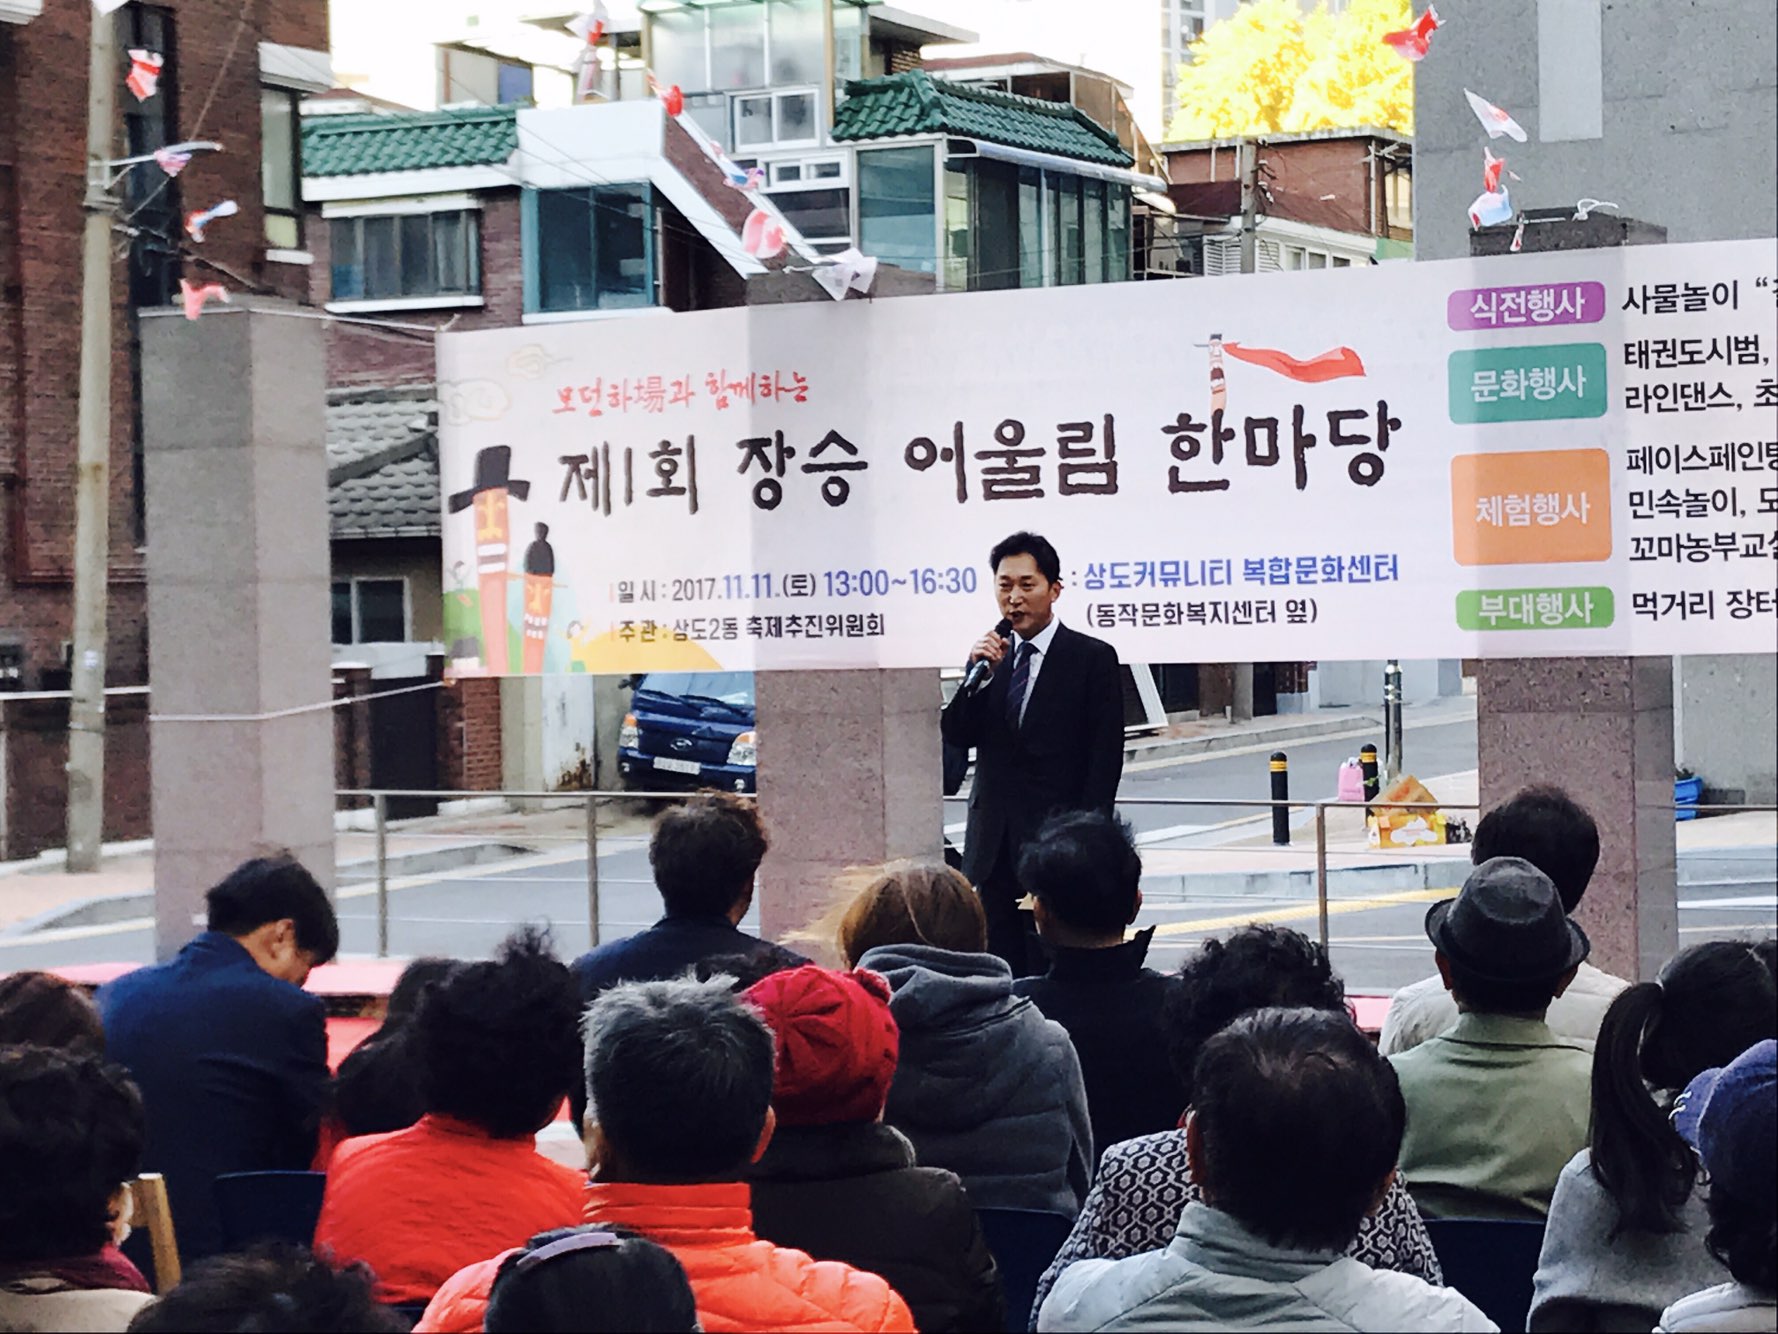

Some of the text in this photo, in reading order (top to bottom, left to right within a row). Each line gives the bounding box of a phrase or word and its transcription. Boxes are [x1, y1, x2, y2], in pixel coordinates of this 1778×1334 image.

[1469, 286, 1586, 326] 식전행사
[1621, 280, 1739, 315] 사물놀이
[1624, 334, 1770, 370] 태권도시범,
[705, 368, 809, 411] 함께하는
[1470, 366, 1586, 403] 문화행사
[1625, 381, 1742, 414] 라인댄스,
[557, 400, 1403, 517] 제1회 장승 어울림 한마당
[1475, 491, 1591, 528] 체험행사
[1629, 486, 1747, 519] 민속놀이,
[823, 567, 977, 598] 13:00~16:30
[1083, 559, 1233, 589] 상도커뮤니티
[1242, 554, 1400, 586] 복합문화센터
[1086, 598, 1318, 628] (동작문화복지센터 옆)
[1478, 588, 1594, 626] 부대행사
[1632, 590, 1715, 621] 먹거리
[672, 616, 739, 641] 상도2동
[745, 612, 886, 639] 축제추진위원회
